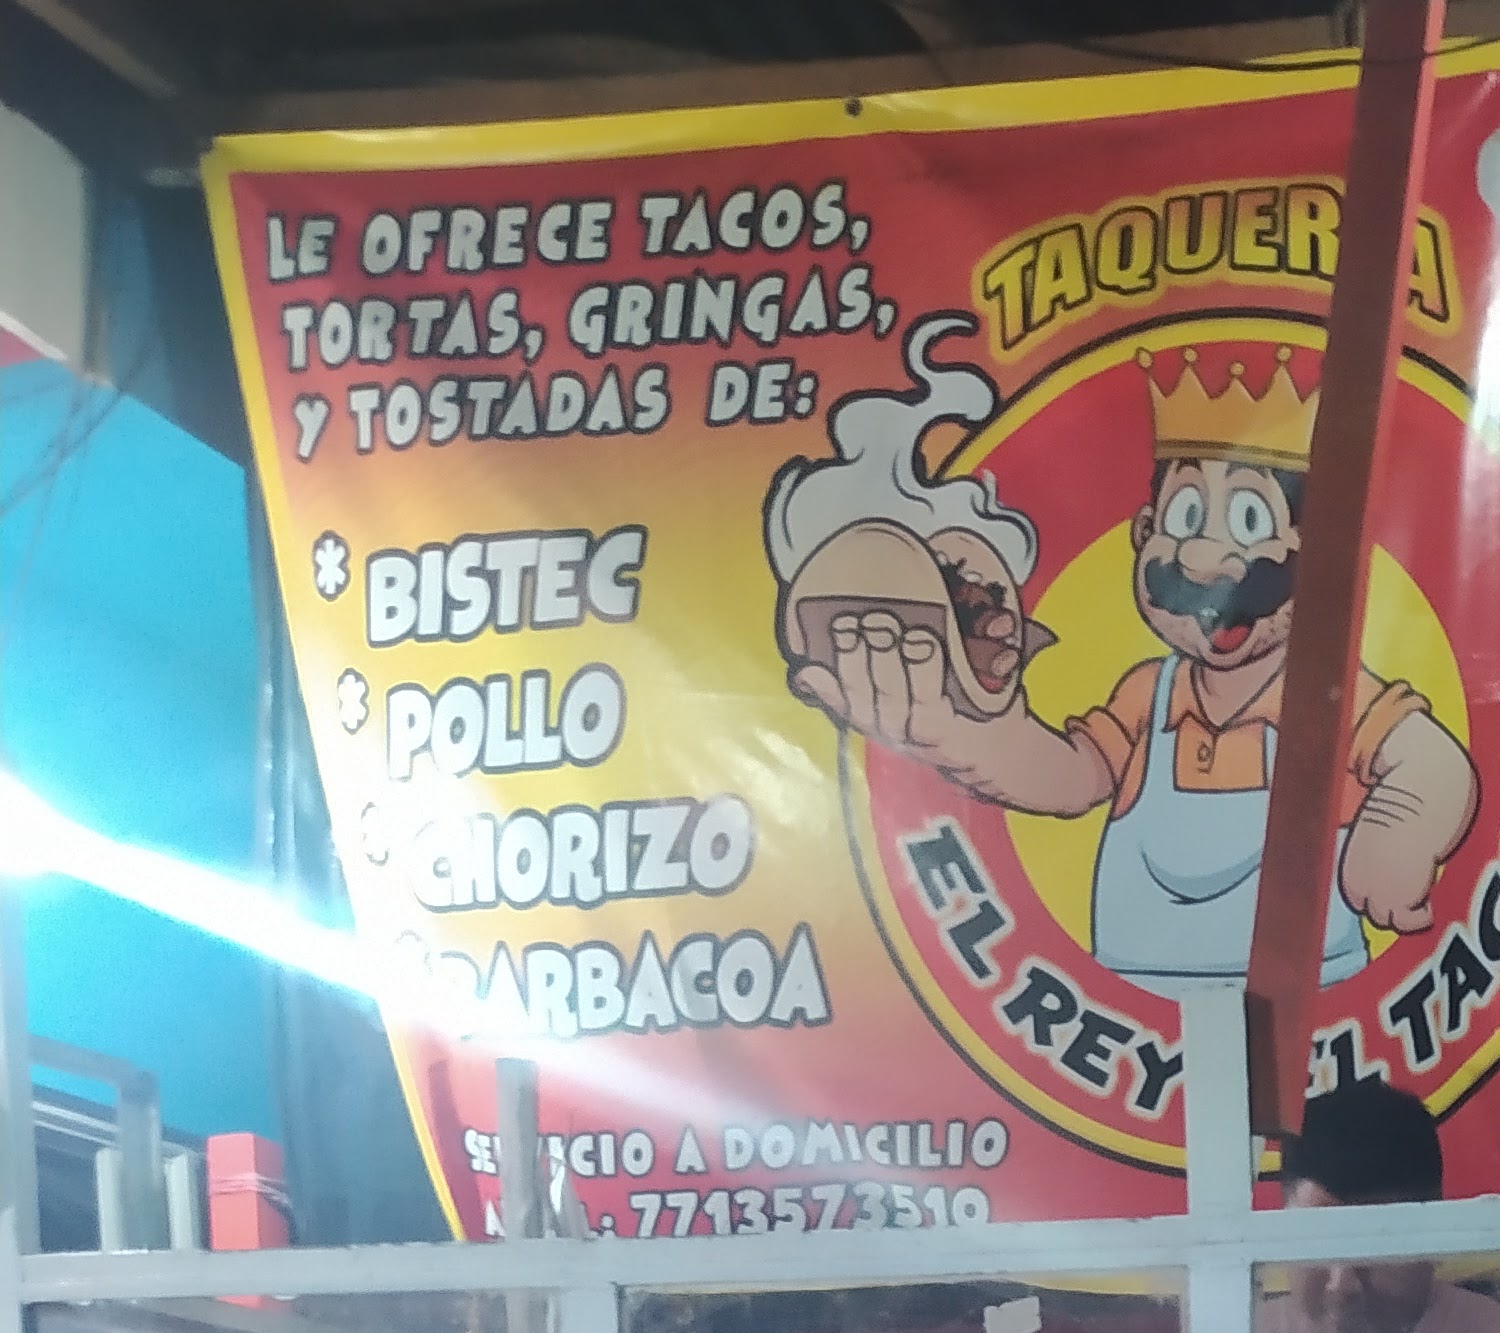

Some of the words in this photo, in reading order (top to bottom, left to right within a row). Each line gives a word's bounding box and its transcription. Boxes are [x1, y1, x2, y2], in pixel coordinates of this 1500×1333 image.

[267, 216, 335, 281] LE
[362, 201, 614, 275] OFRECE
[641, 184, 870, 254] TACOS,
[983, 183, 1451, 349] TAQUERA
[283, 292, 545, 370] TORTAS,
[569, 268, 896, 355] GRINGAS,
[350, 362, 669, 453] TOSTADAS
[706, 359, 819, 428] DE:
[366, 524, 648, 648] BISTEC
[386, 662, 626, 781] POLLO
[409, 793, 753, 912] CHORIZO
[907, 825, 1004, 980] EL
[1002, 966, 1184, 1111] REY
[464, 1128, 655, 1179] SEICIO
[673, 1122, 709, 1175] A
[721, 1116, 1010, 1171] DOMICILIO
[628, 1180, 991, 1238] 7713573510
